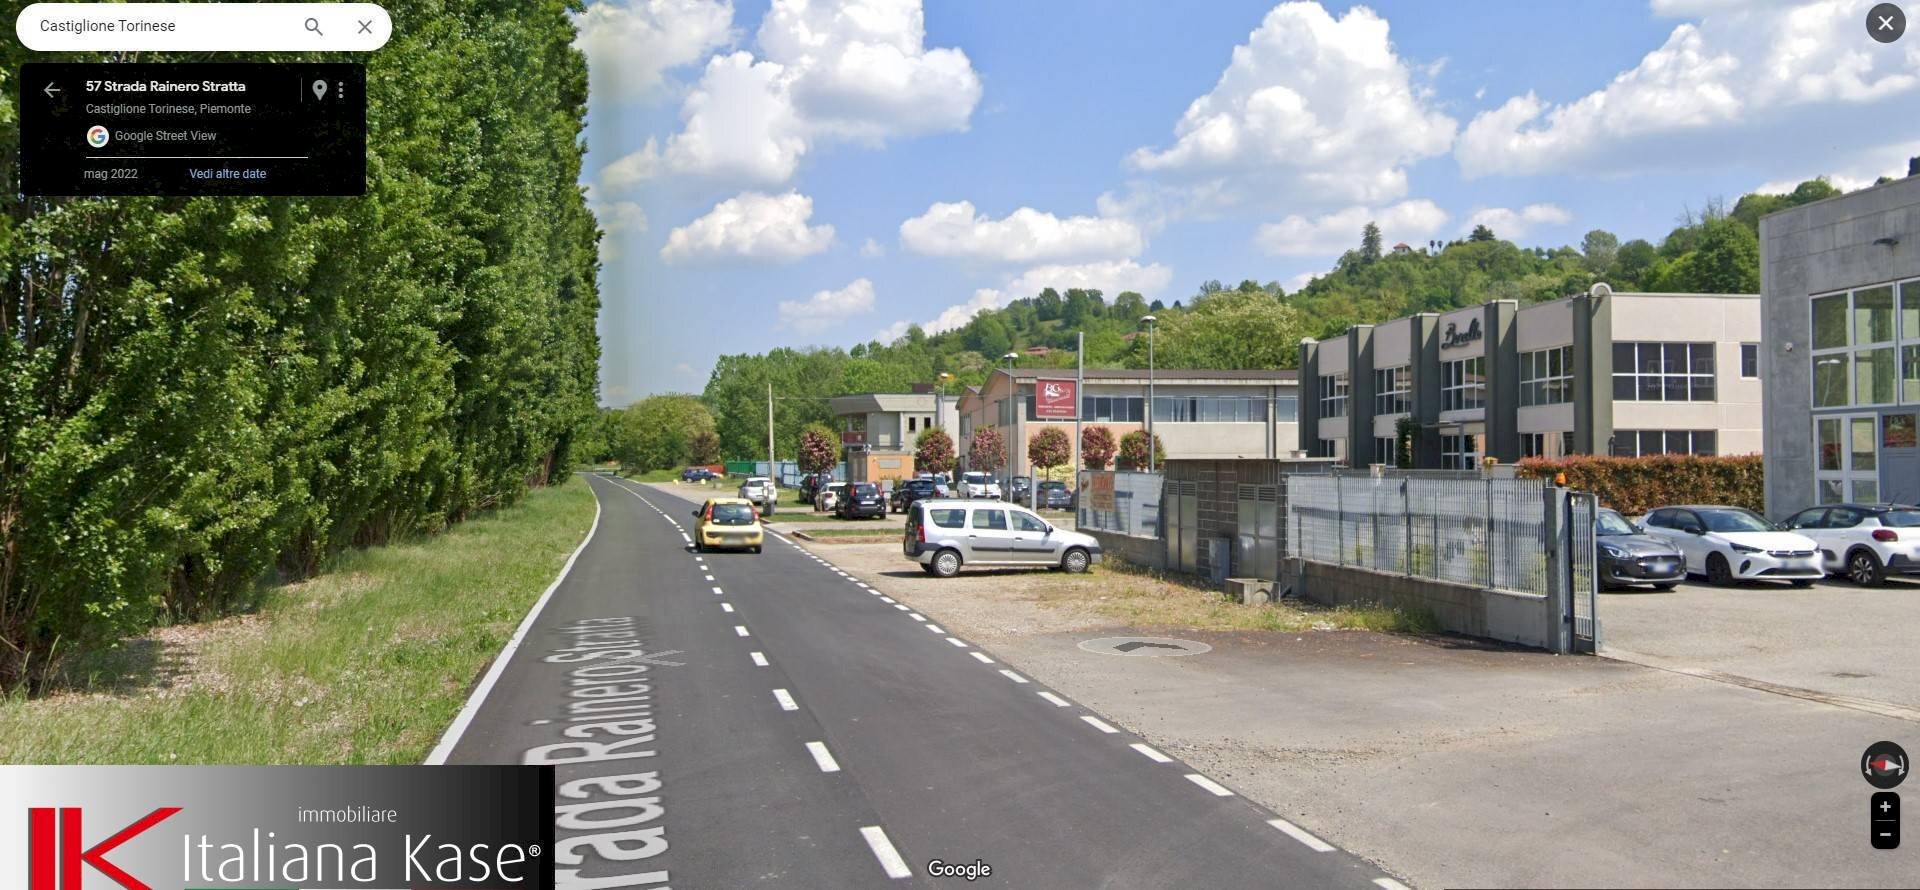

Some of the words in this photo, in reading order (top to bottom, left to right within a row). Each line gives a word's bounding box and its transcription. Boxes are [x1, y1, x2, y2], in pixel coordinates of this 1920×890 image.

[544, 616, 644, 662] Stratta
[523, 665, 657, 765] Rainero
[555, 771, 673, 890] rada
